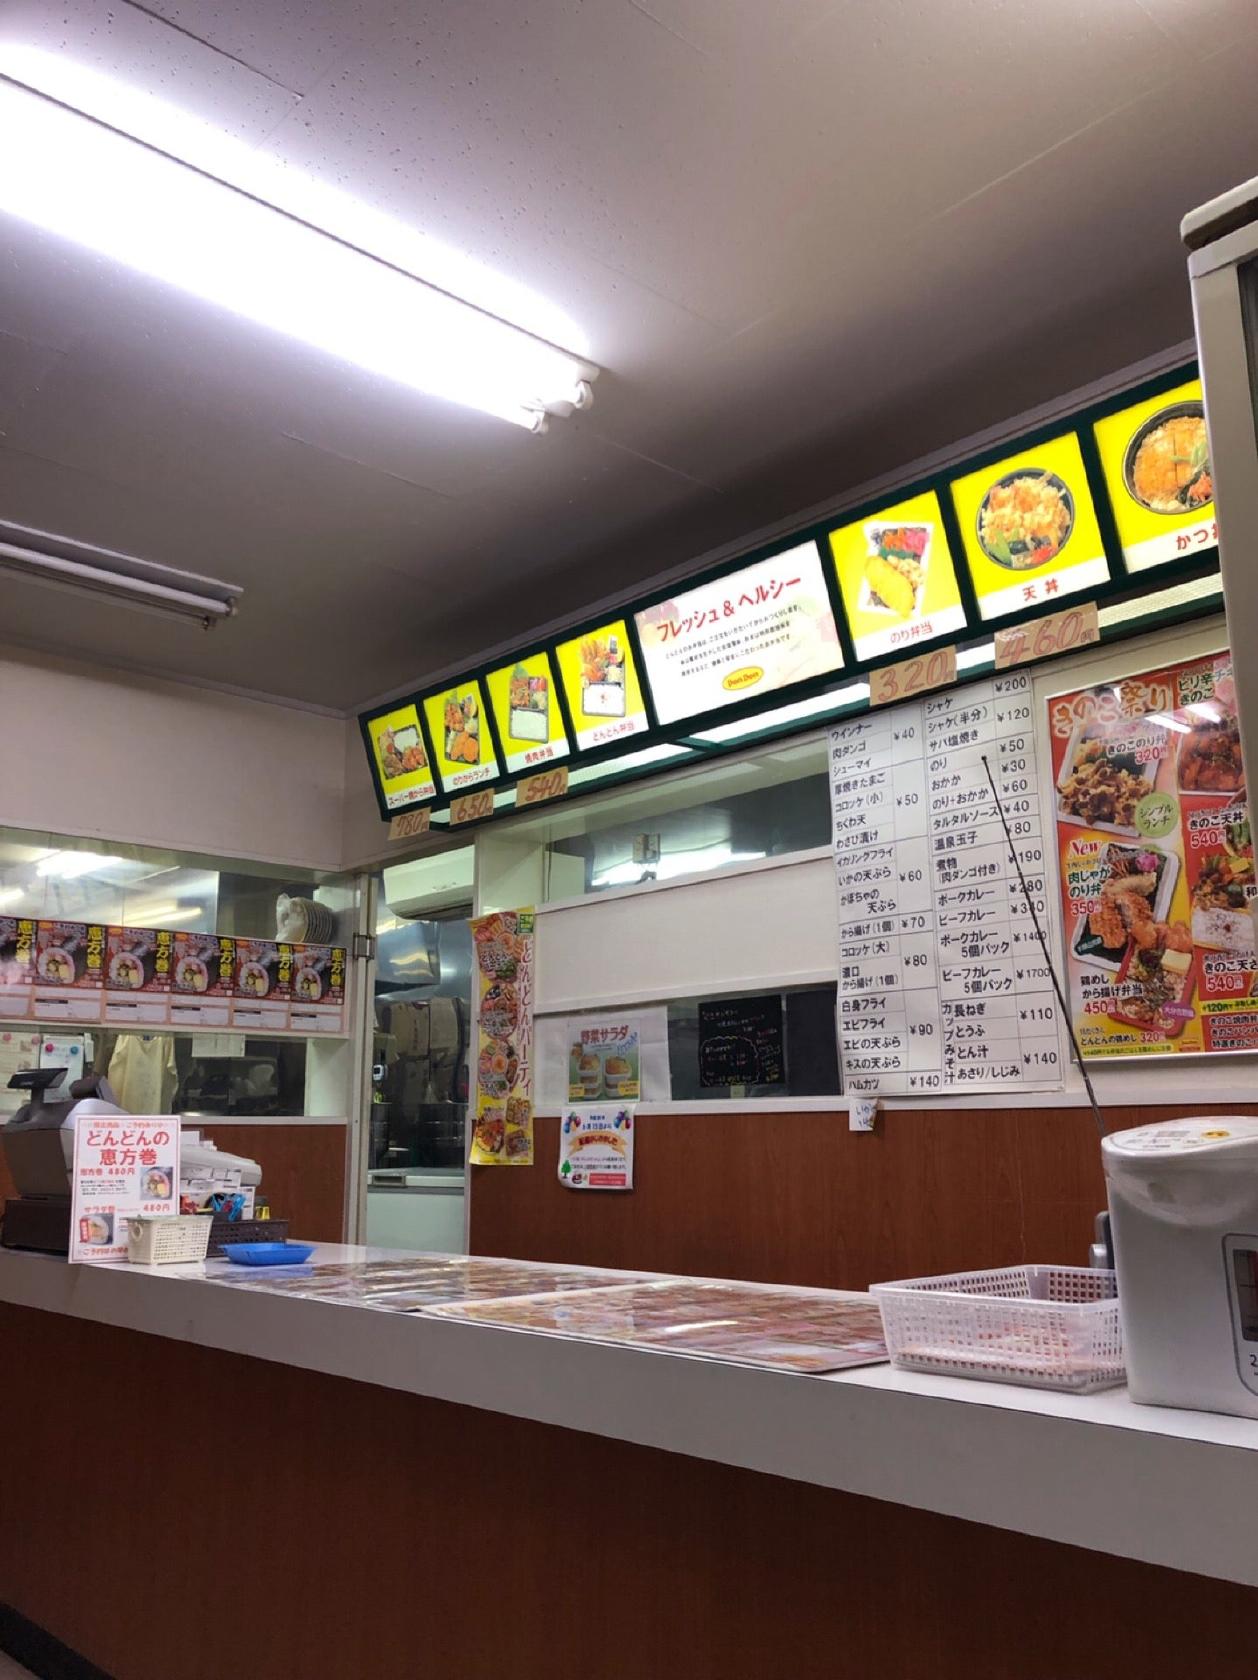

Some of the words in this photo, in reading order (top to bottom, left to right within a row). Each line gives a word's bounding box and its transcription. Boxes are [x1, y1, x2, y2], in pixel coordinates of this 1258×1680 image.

[1021, 578, 1060, 602] 天丼
[890, 621, 934, 644] のり弁当
[995, 676, 1027, 692] ¥200
[1181, 687, 1214, 705] きのこ
[927, 697, 953, 714] シャケ
[997, 707, 1030, 722] ¥120
[831, 723, 873, 741] ウインナー
[894, 727, 915, 740] ¥40
[930, 729, 979, 751] サバ塩焼き
[1000, 738, 1025, 753] ¥50
[833, 740, 866, 760] 肉ダンゴ
[833, 758, 871, 776] シューマイ
[930, 757, 947, 772] のり
[1001, 759, 1026, 773] ¥30
[931, 775, 961, 791] おかか
[1002, 779, 1028, 793] ¥60
[896, 793, 919, 806] ¥50
[1003, 800, 1030, 814] ¥40
[836, 814, 866, 831] ちくわ天
[934, 806, 999, 830] タルタルソース
[1190, 811, 1244, 830] きのこ天丼
[934, 830, 978, 851] 温泉玉子
[1072, 840, 1099, 856] New
[838, 866, 891, 886] いかの天ぷら
[899, 869, 922, 882] ¥60
[1068, 867, 1110, 884] 肉じゃが
[841, 889, 880, 906] かぼちゃの
[938, 888, 995, 906] ポークカレー
[867, 899, 896, 914] 天ぷら
[901, 916, 926, 928] ¥70
[939, 909, 996, 926] ビーフカレー
[941, 930, 998, 948] ポークカレー
[904, 954, 928, 967] ¥80
[942, 966, 1001, 982] ビーフカレー
[1016, 967, 1051, 981] ¥1700
[1080, 974, 1109, 986] 鶏めし
[1082, 984, 1143, 999] から揚げ弁当
[842, 997, 886, 1012] 白身フライ
[954, 1002, 986, 1018] 長ねぎ
[1020, 1007, 1053, 1020] ¥110
[842, 1017, 885, 1031] エビフライ
[909, 1024, 933, 1036] ¥90
[581, 1025, 629, 1044] 野菜サラダ
[955, 1025, 985, 1039] とうふ
[843, 1036, 901, 1050] エビの天ぷら
[957, 1045, 989, 1060] とん汁
[1024, 1052, 1058, 1064] ¥140
[846, 1056, 901, 1069] キスの天ぷら
[957, 1065, 1020, 1080] あさり/しじみ
[848, 1079, 880, 1090] ハムカツ
[910, 1075, 940, 1088] ¥140
[87, 1130, 170, 1146] どんどんの
[100, 1149, 158, 1166] 恵方巻
